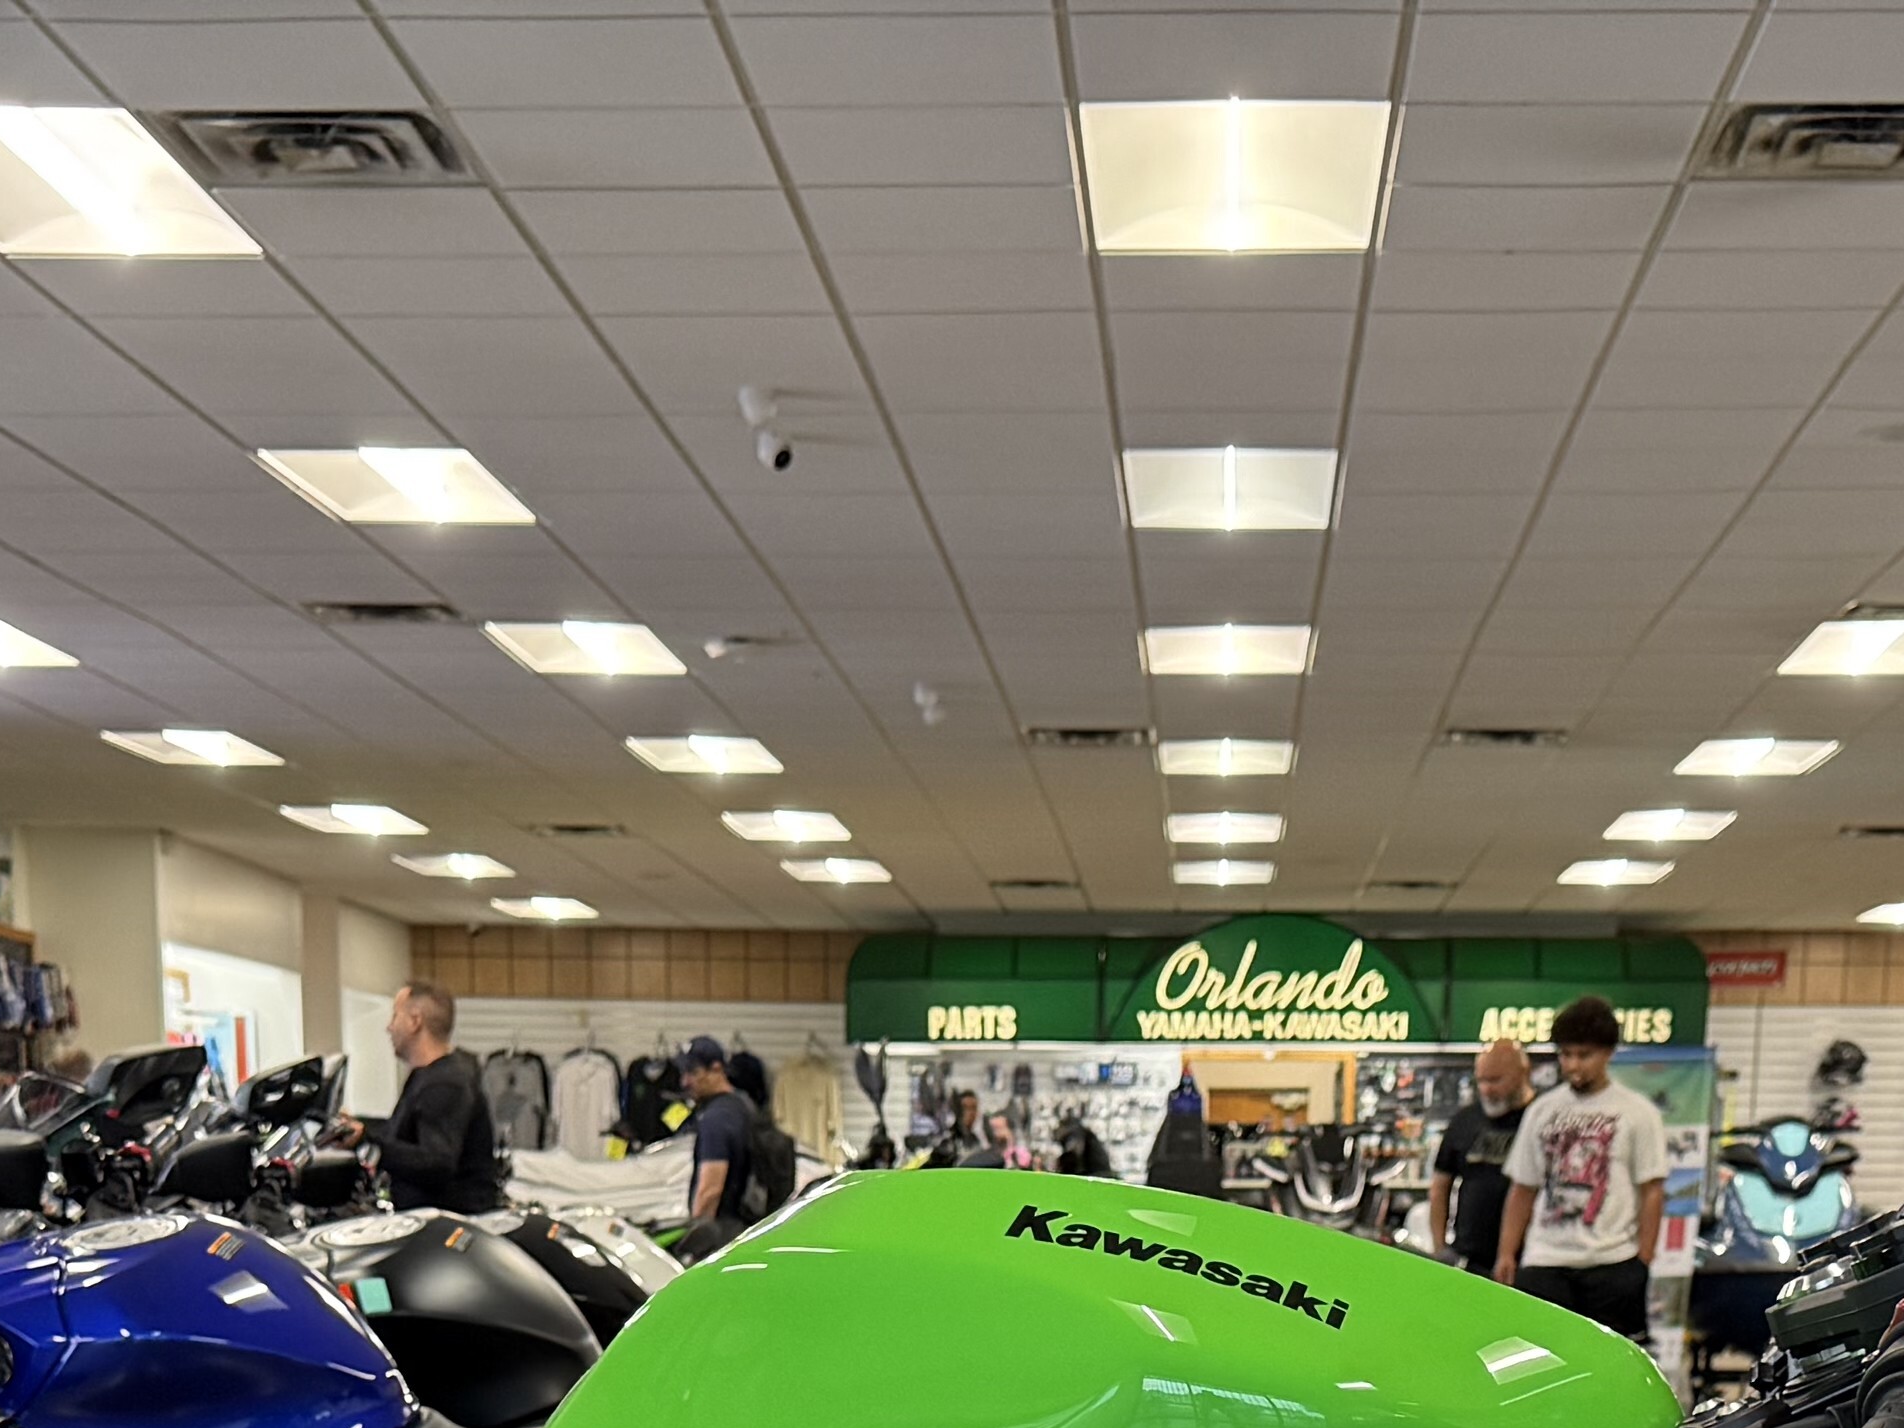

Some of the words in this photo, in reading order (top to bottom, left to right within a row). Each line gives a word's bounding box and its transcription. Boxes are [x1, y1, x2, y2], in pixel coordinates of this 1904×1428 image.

[1154, 937, 1389, 1011] Orlando
[927, 1005, 1017, 1040] PARTS
[1136, 1010, 1409, 1041] YAMAHA-KAWASAKI
[1478, 1007, 1674, 1044] ACCEIES
[1004, 1203, 1351, 1331] Kawasaki
